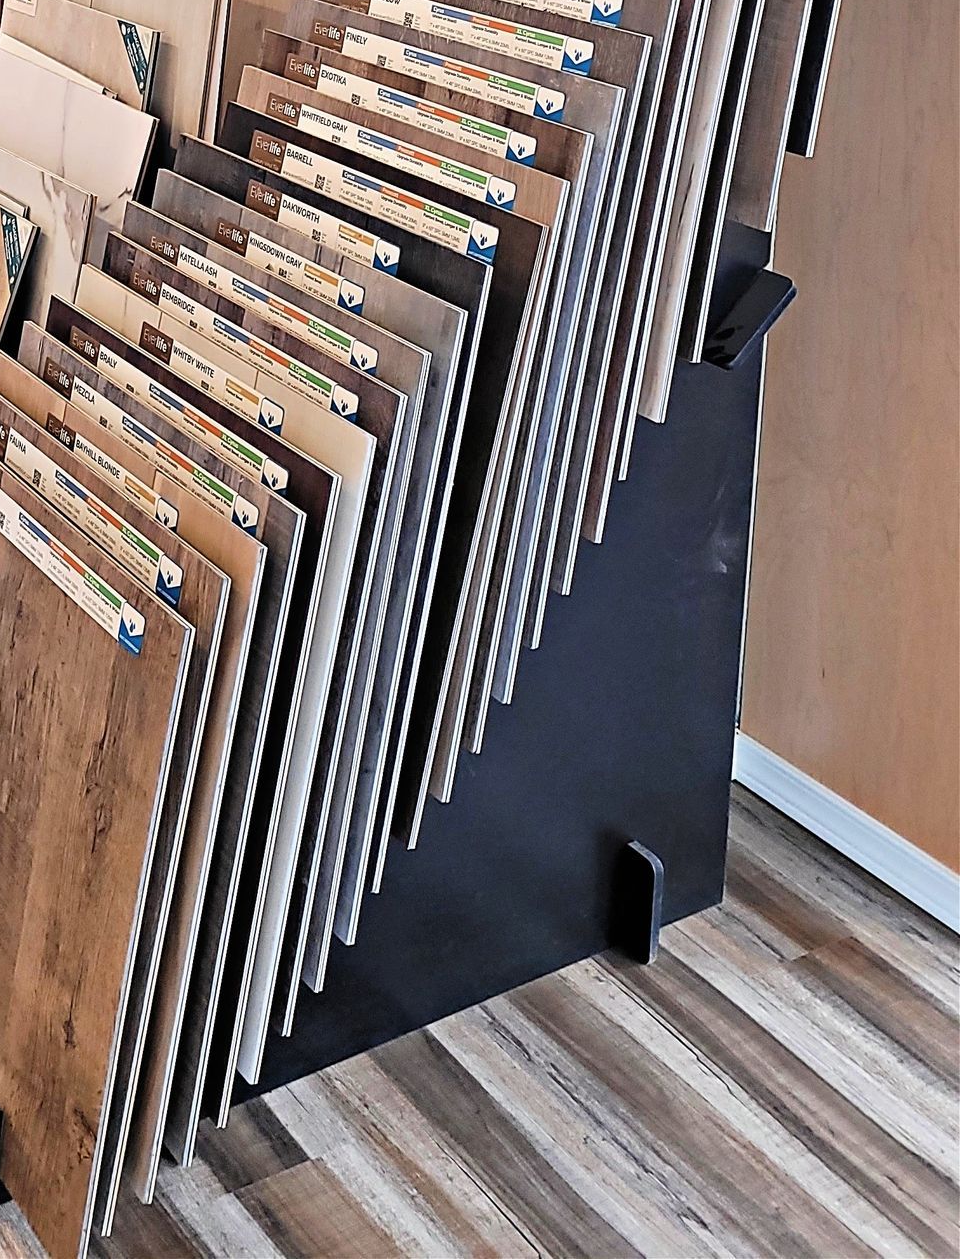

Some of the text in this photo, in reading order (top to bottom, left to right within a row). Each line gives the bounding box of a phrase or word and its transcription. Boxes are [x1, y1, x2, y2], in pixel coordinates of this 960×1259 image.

[314, 22, 340, 40] Everlife
[346, 32, 368, 45] FINELY
[290, 59, 315, 78] Everlife
[321, 70, 346, 86] EXOTIKA
[271, 98, 296, 118] Everlife
[302, 109, 347, 133] WHITFIELD GRAY
[256, 136, 281, 156] Everlife
[286, 149, 313, 167] BARRELL
[219, 223, 243, 244] Everlife
[150, 236, 175, 258] Everlife
[250, 236, 302, 269] KINGSDOWN GRAY
[180, 251, 217, 278] KATELLA ASH
[162, 289, 195, 315] BEMBRIDGE
[100, 351, 117, 369] BRALY
[174, 345, 214, 378] WHITBY WHITE
[74, 382, 95, 404] MEZCLA
[9, 434, 26, 454] FAUNA
[76, 439, 120, 479] BAYHILL BLONDE
